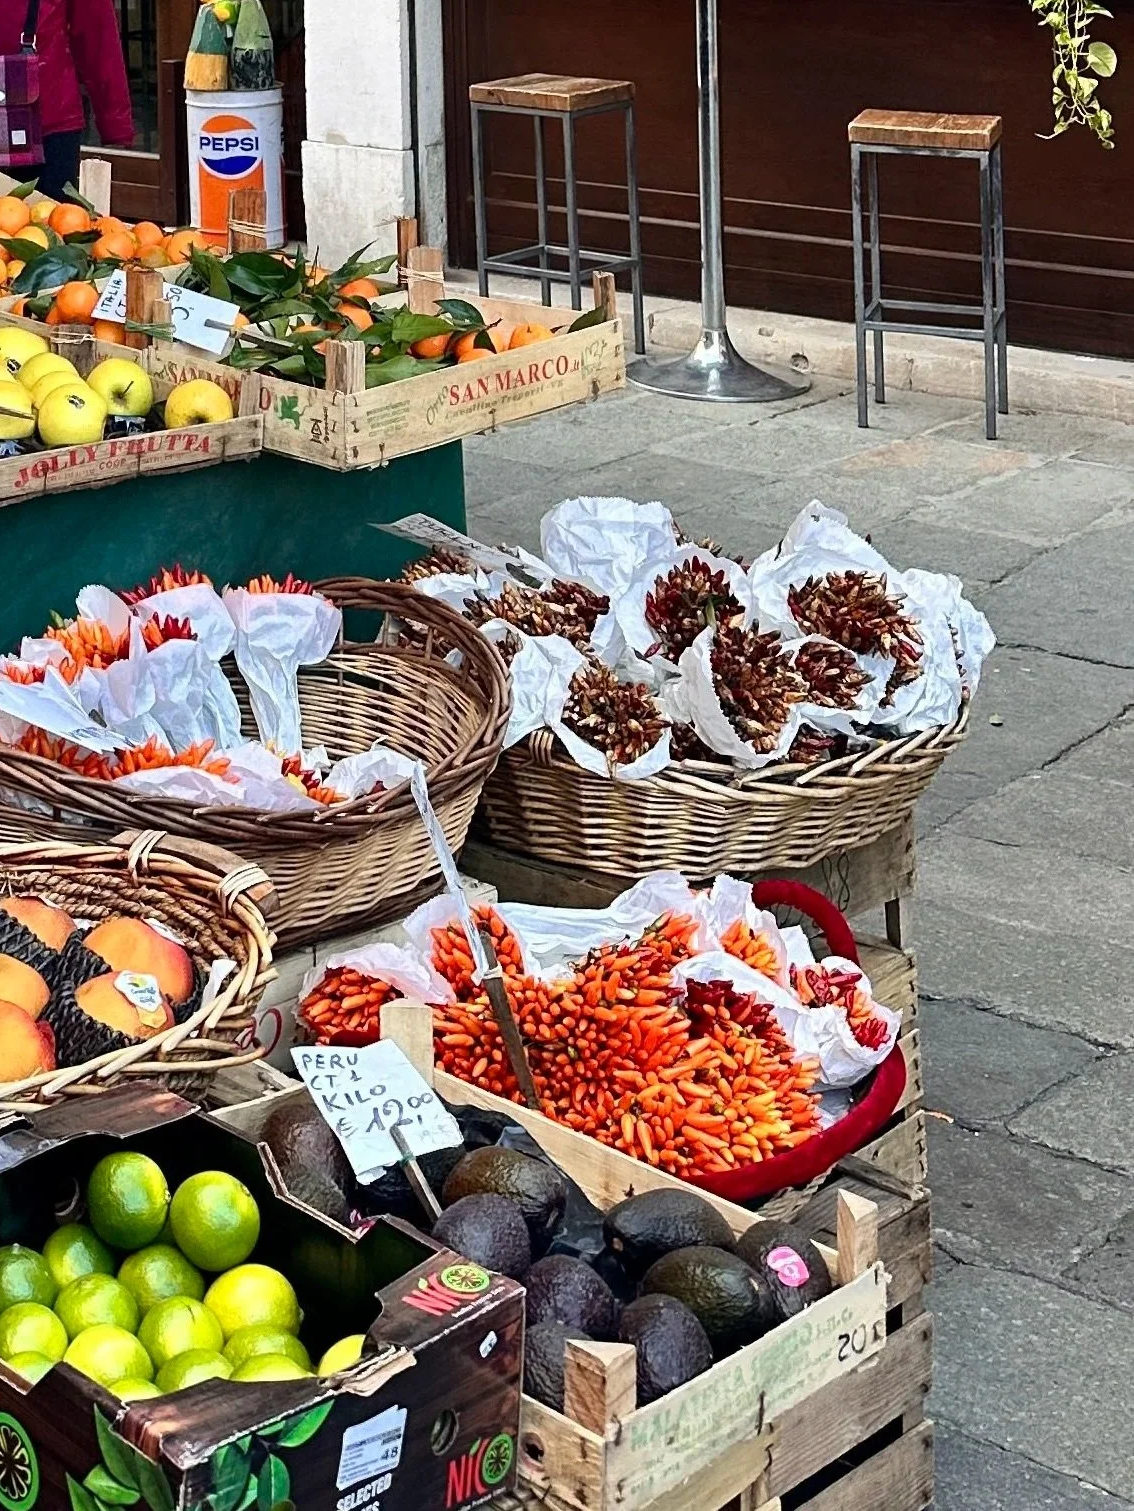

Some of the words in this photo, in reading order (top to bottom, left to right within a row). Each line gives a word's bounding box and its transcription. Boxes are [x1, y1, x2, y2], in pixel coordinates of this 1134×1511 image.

[199, 136, 259, 152] PEPSI
[100, 278, 123, 313] ITALIA
[449, 374, 491, 406] SAN
[494, 354, 569, 394] MARCO
[15, 443, 99, 488] JOLLY
[109, 433, 211, 458] FRUTTA
[301, 1052, 359, 1072] PERU
[321, 1084, 387, 1113] KILO
[380, 1446, 399, 1461] 48
[336, 1472, 393, 1511] SELECTED
